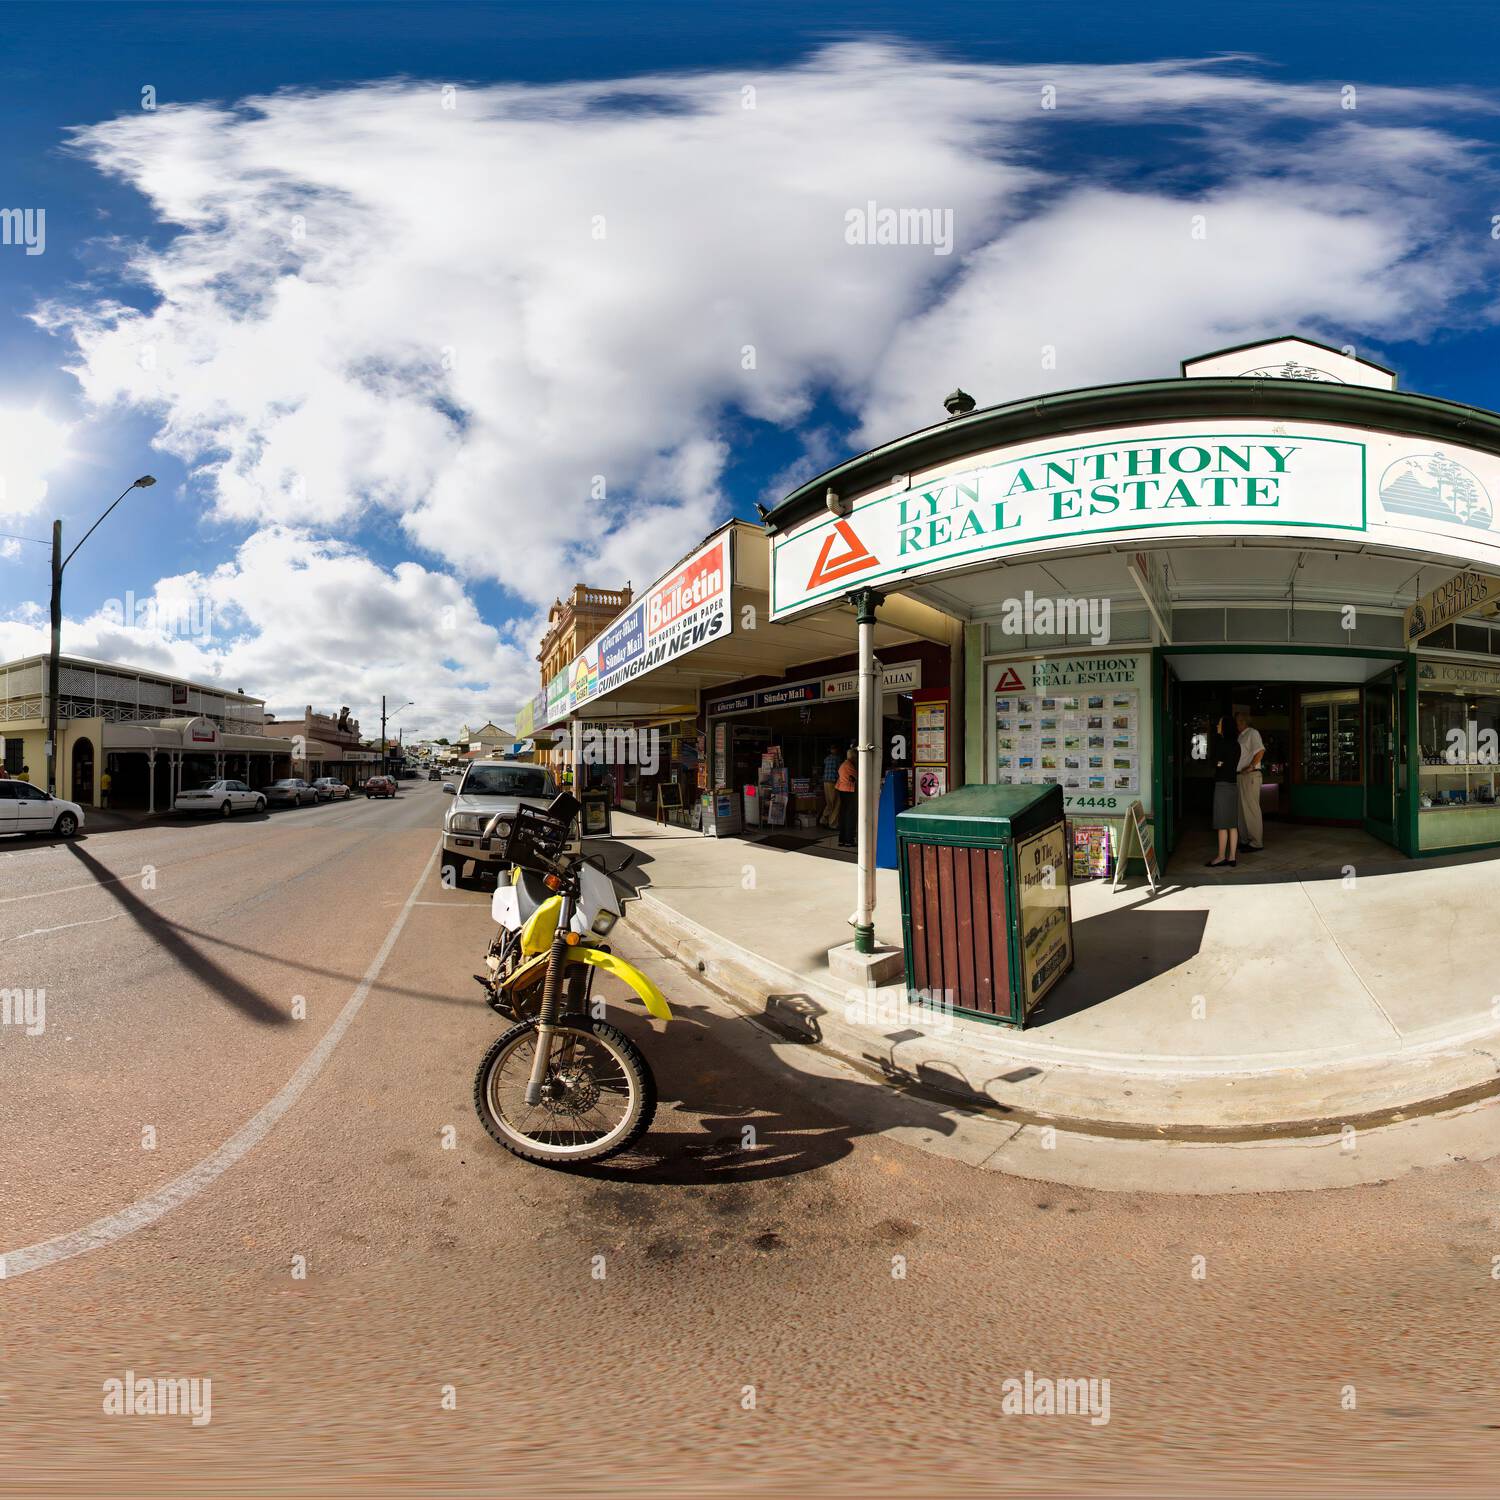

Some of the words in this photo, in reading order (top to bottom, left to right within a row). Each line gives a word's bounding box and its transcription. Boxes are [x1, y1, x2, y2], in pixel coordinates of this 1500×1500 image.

[897, 475, 981, 528] LYN
[1007, 445, 1303, 498] ANTHONY
[896, 502, 1023, 557] REAL
[1048, 477, 1282, 521] ESTATE
[650, 568, 721, 629] Bulletin
[682, 612, 698, 628] OWN
[700, 598, 724, 619] PAPER
[598, 642, 667, 694] CUNNINGHAM
[668, 612, 724, 656] NEWS
[1032, 662, 1060, 675] LYN
[1065, 658, 1139, 673] ANTHONY
[837, 682, 853, 692] THE
[1032, 674, 1071, 687] REAL
[1077, 671, 1135, 684] ESTATE
[1077, 797, 1117, 808] 4448
